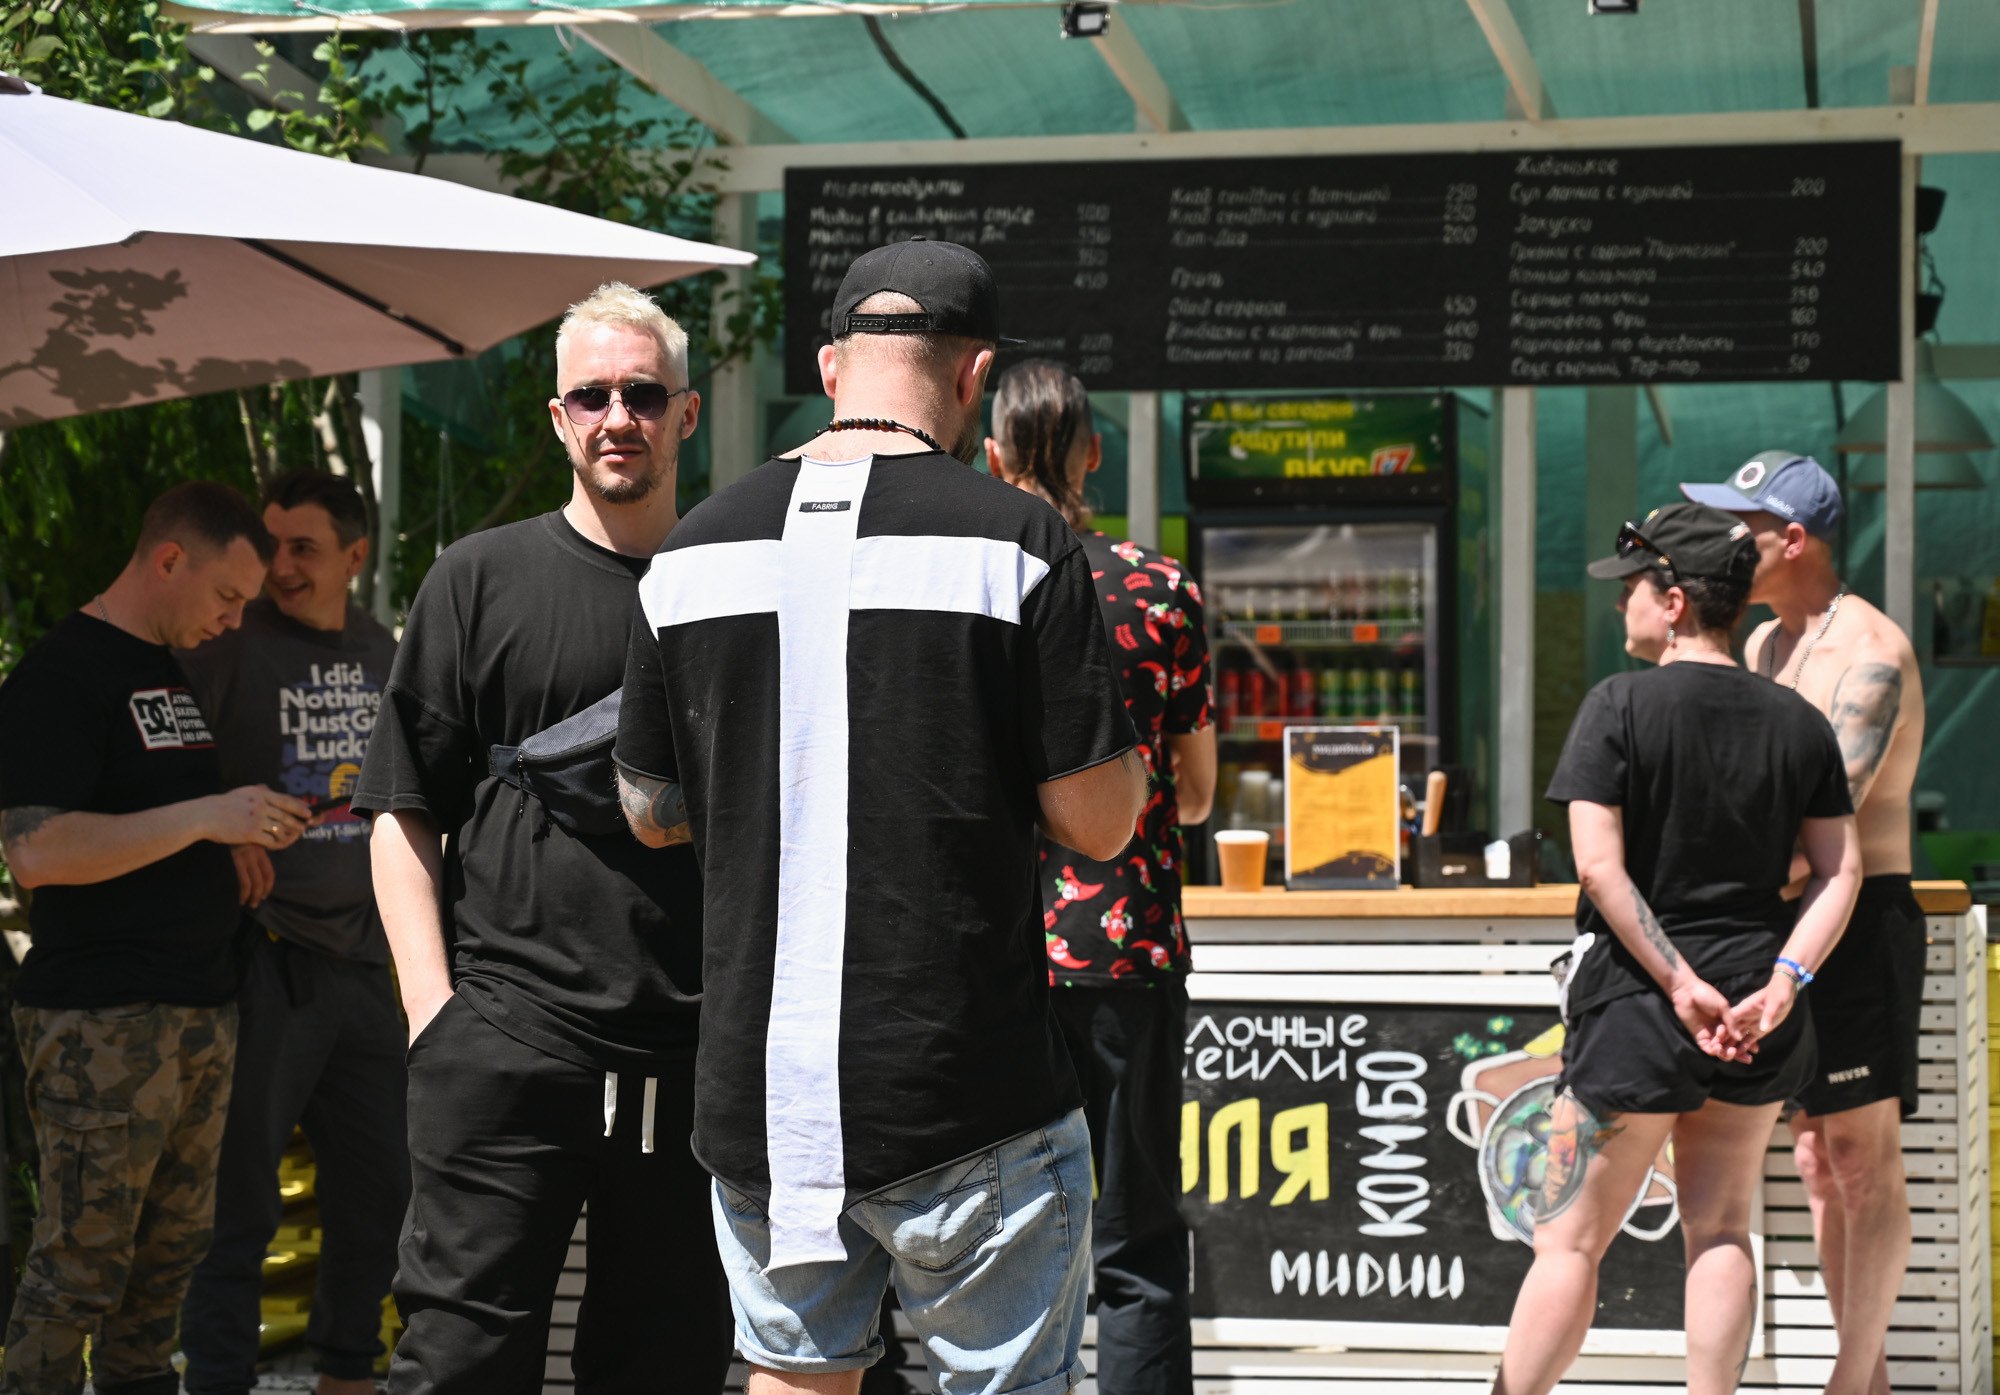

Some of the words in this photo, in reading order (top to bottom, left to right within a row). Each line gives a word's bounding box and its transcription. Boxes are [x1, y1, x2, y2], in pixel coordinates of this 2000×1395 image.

[1790, 176, 1827, 199] 200
[1795, 236, 1829, 257] 200
[324, 662, 365, 687] did
[296, 731, 369, 761] Luck
